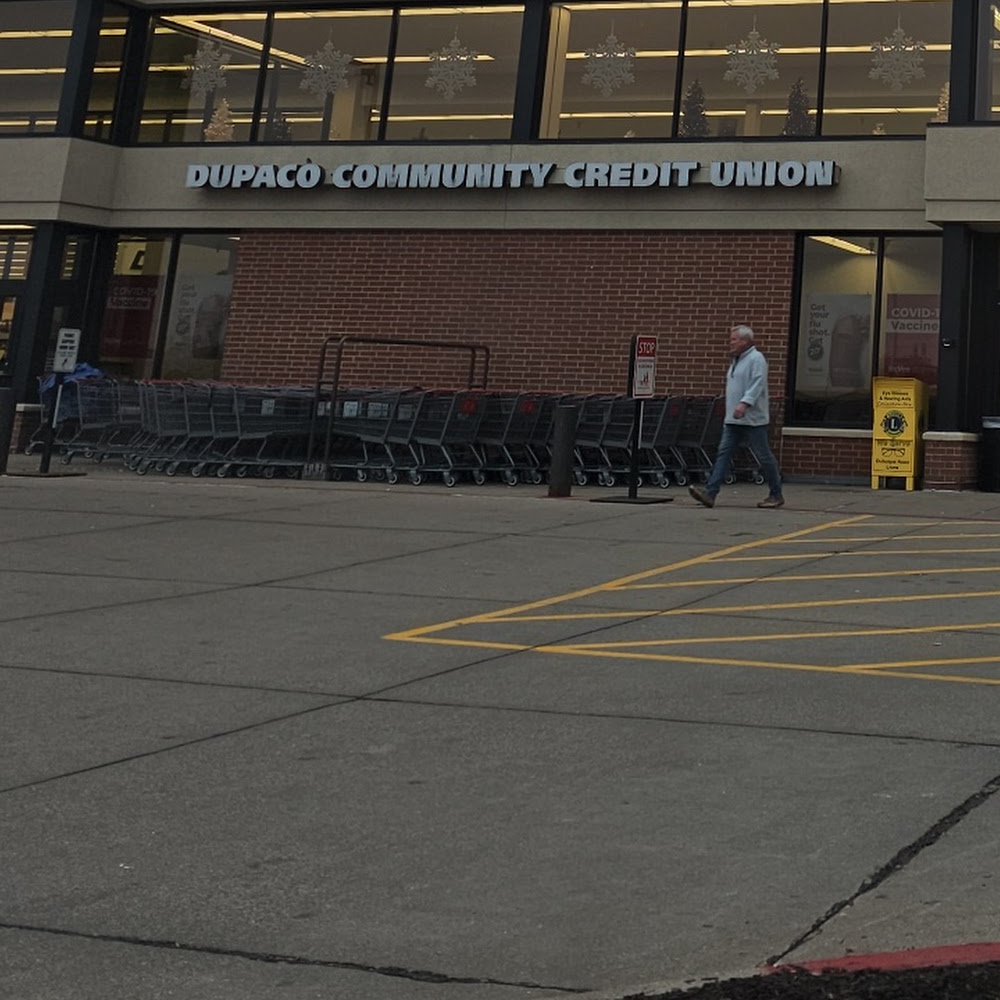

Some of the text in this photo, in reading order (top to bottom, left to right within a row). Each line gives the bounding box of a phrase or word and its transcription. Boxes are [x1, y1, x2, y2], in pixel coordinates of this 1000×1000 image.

[186, 161, 837, 189] DUPACO COMMUNITY CREDIT UNION
[891, 307, 940, 318] COVID-1
[891, 320, 939, 332] Vaccine
[638, 342, 656, 354] STOP
